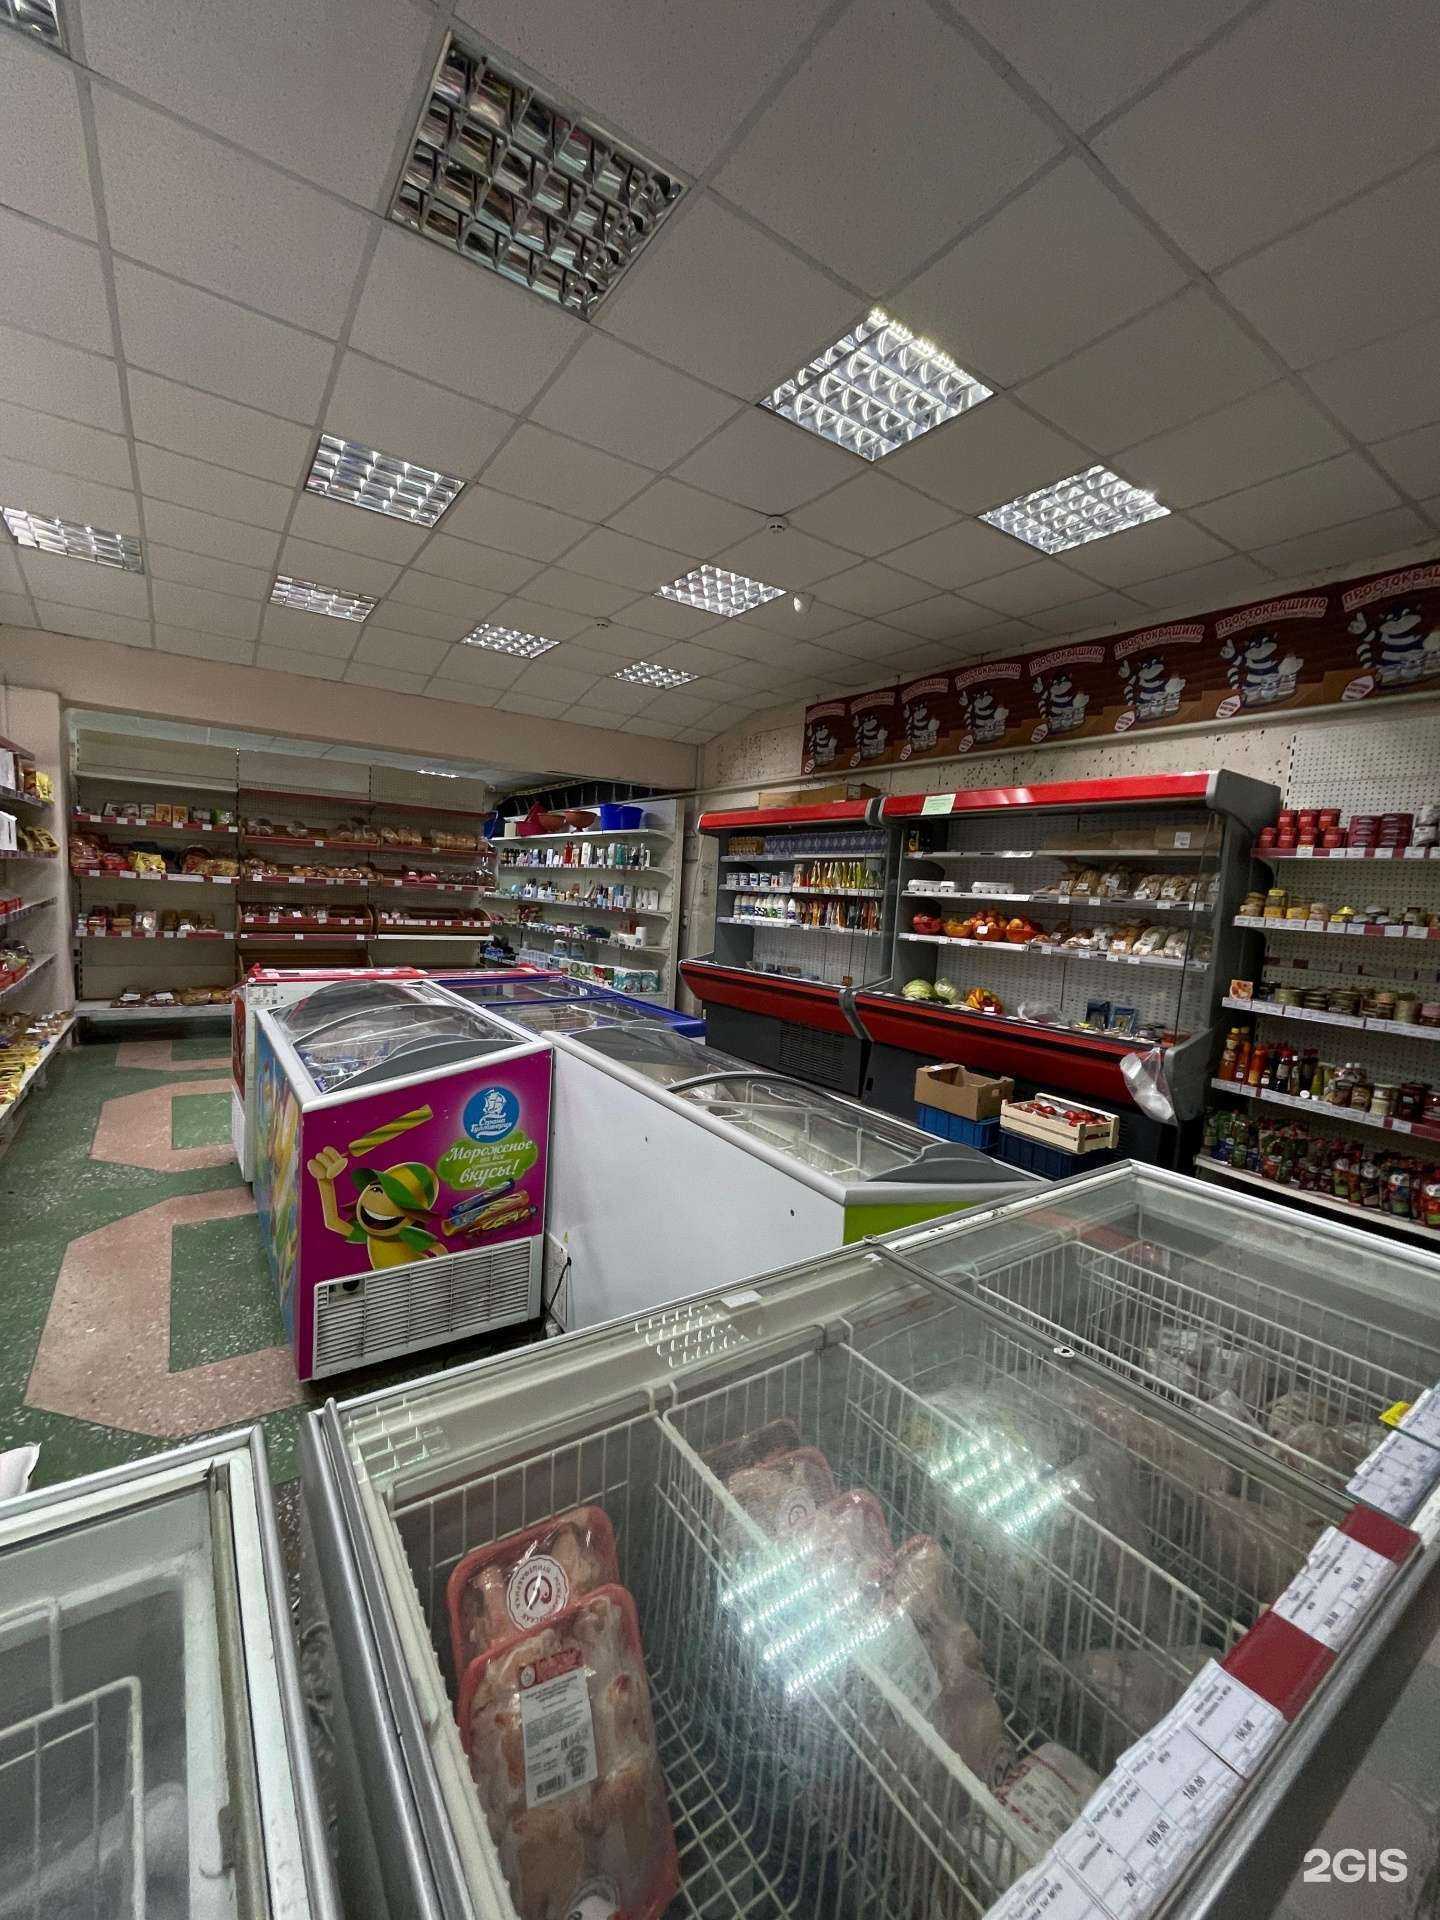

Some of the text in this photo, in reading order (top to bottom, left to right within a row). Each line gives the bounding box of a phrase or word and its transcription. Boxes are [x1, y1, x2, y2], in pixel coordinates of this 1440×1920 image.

[1216, 598, 1327, 631] ПРОСТОКВАШИНО
[447, 1141, 533, 1164] Мороженое
[460, 1159, 519, 1187] вкусы!
